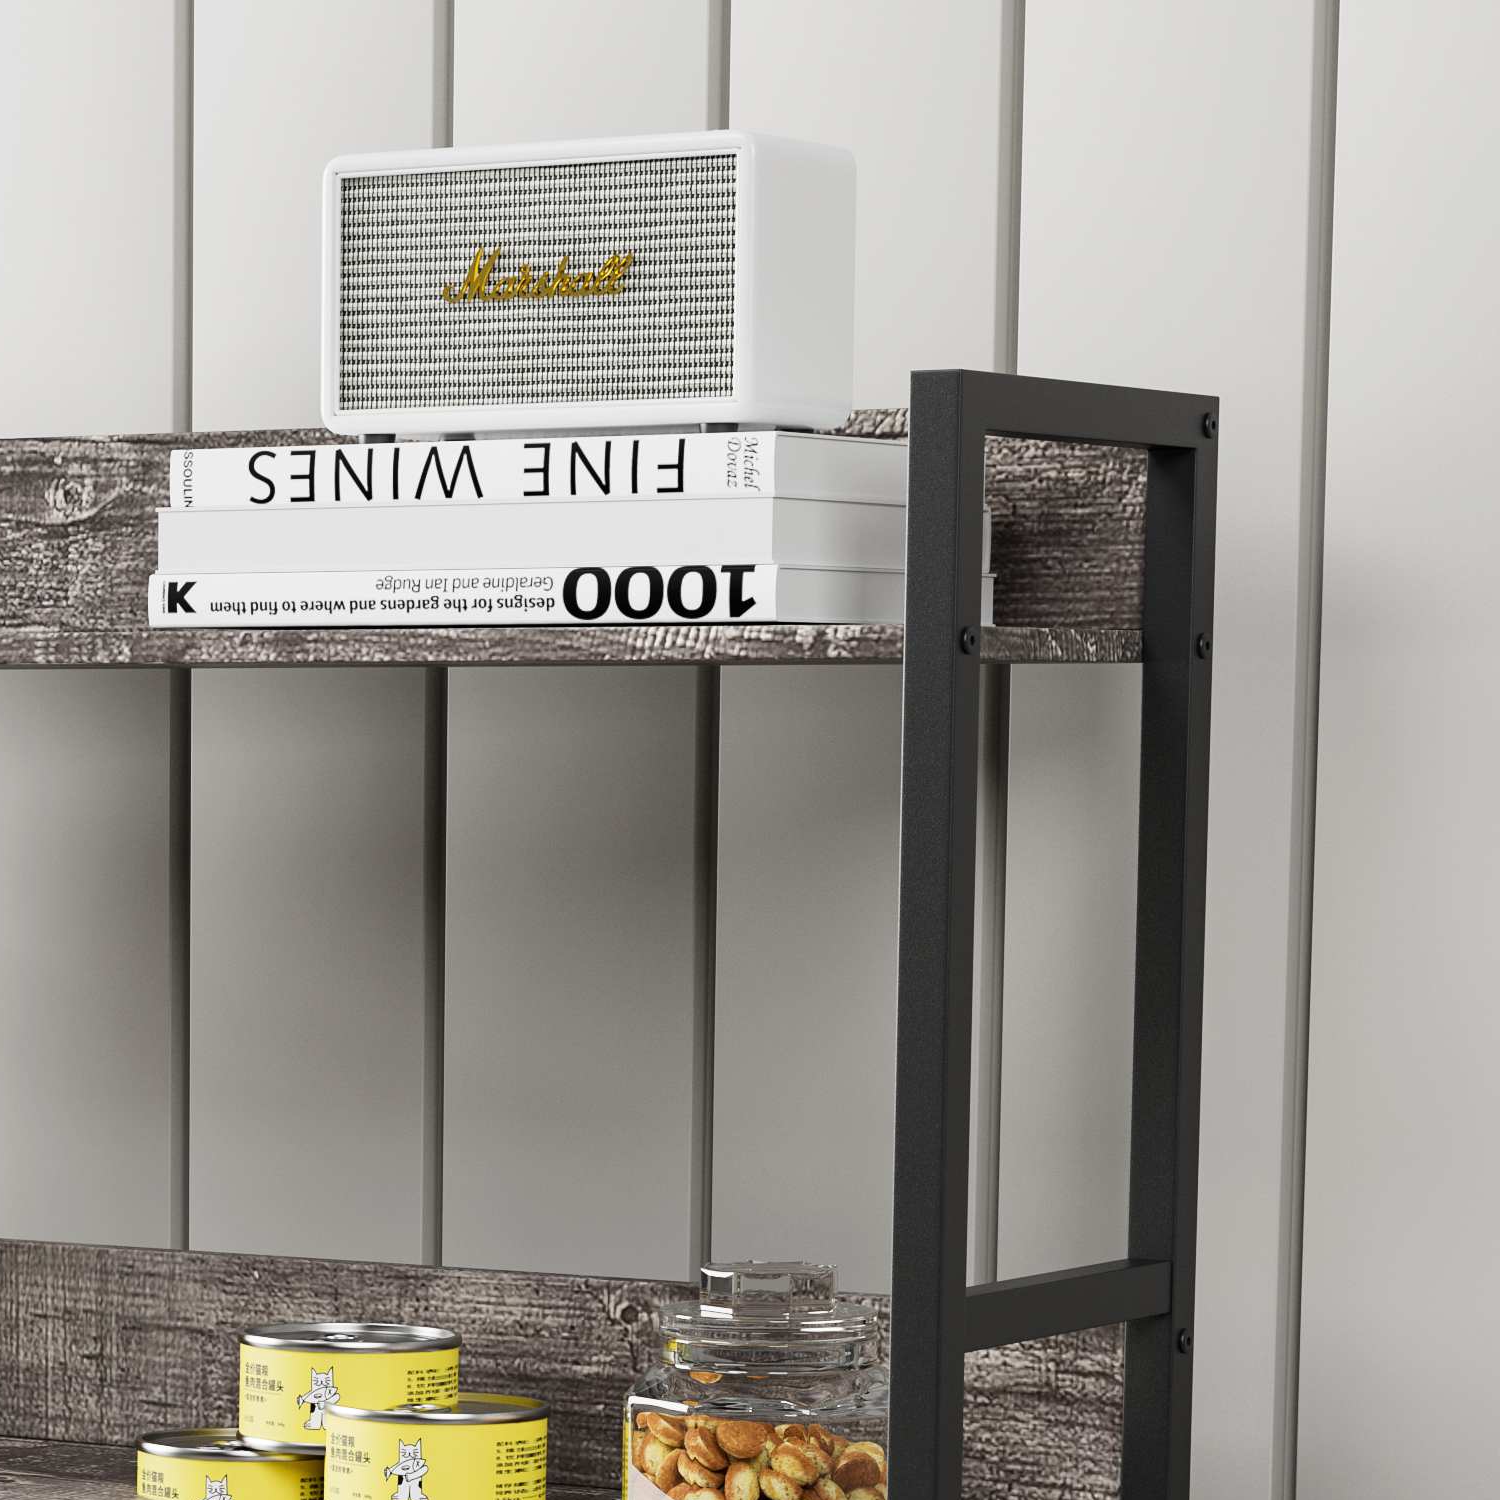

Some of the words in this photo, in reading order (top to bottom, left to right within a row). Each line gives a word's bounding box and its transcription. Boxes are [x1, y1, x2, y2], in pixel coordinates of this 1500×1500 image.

[442, 246, 634, 303] Marshall
[523, 438, 686, 497] FINE
[726, 437, 741, 488] Dovaz
[744, 437, 760, 492] Michel
[183, 451, 194, 508] SSOULIN
[248, 445, 484, 504] WINES
[375, 575, 421, 593] Rudge
[425, 578, 448, 593] Ian
[452, 576, 479, 590] and
[483, 576, 554, 593] Geraldine
[167, 581, 197, 614] K
[562, 564, 757, 620] 1000
[210, 600, 247, 615] them
[250, 600, 279, 616] find
[281, 600, 297, 614] to
[300, 600, 346, 614] where
[350, 598, 376, 612] and
[380, 595, 440, 612] gardens
[443, 597, 468, 613] the
[471, 597, 494, 612] for
[496, 594, 555, 613] designs
